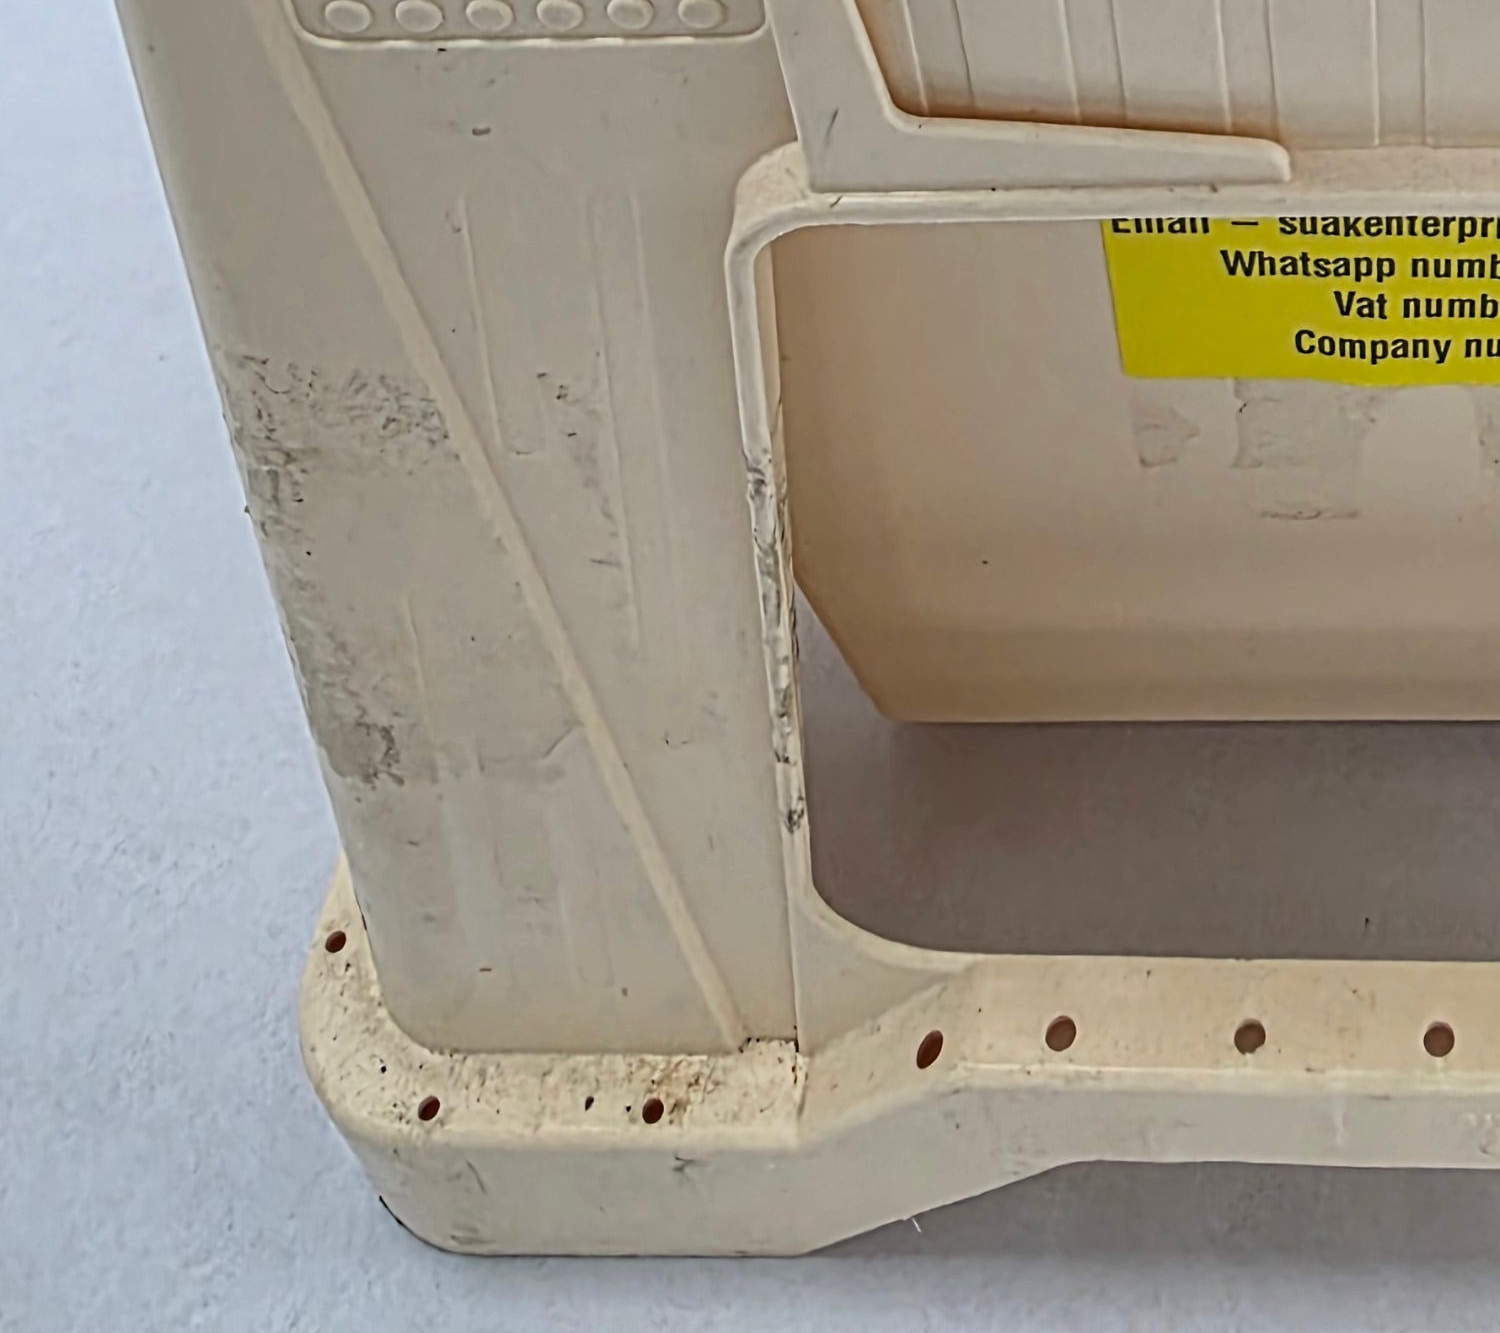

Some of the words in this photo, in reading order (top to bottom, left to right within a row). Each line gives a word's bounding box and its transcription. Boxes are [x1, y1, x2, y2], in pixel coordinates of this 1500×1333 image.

[1219, 249, 1396, 283] Whatsapp
[1333, 290, 1388, 320] Vat
[1294, 329, 1452, 366] Company
